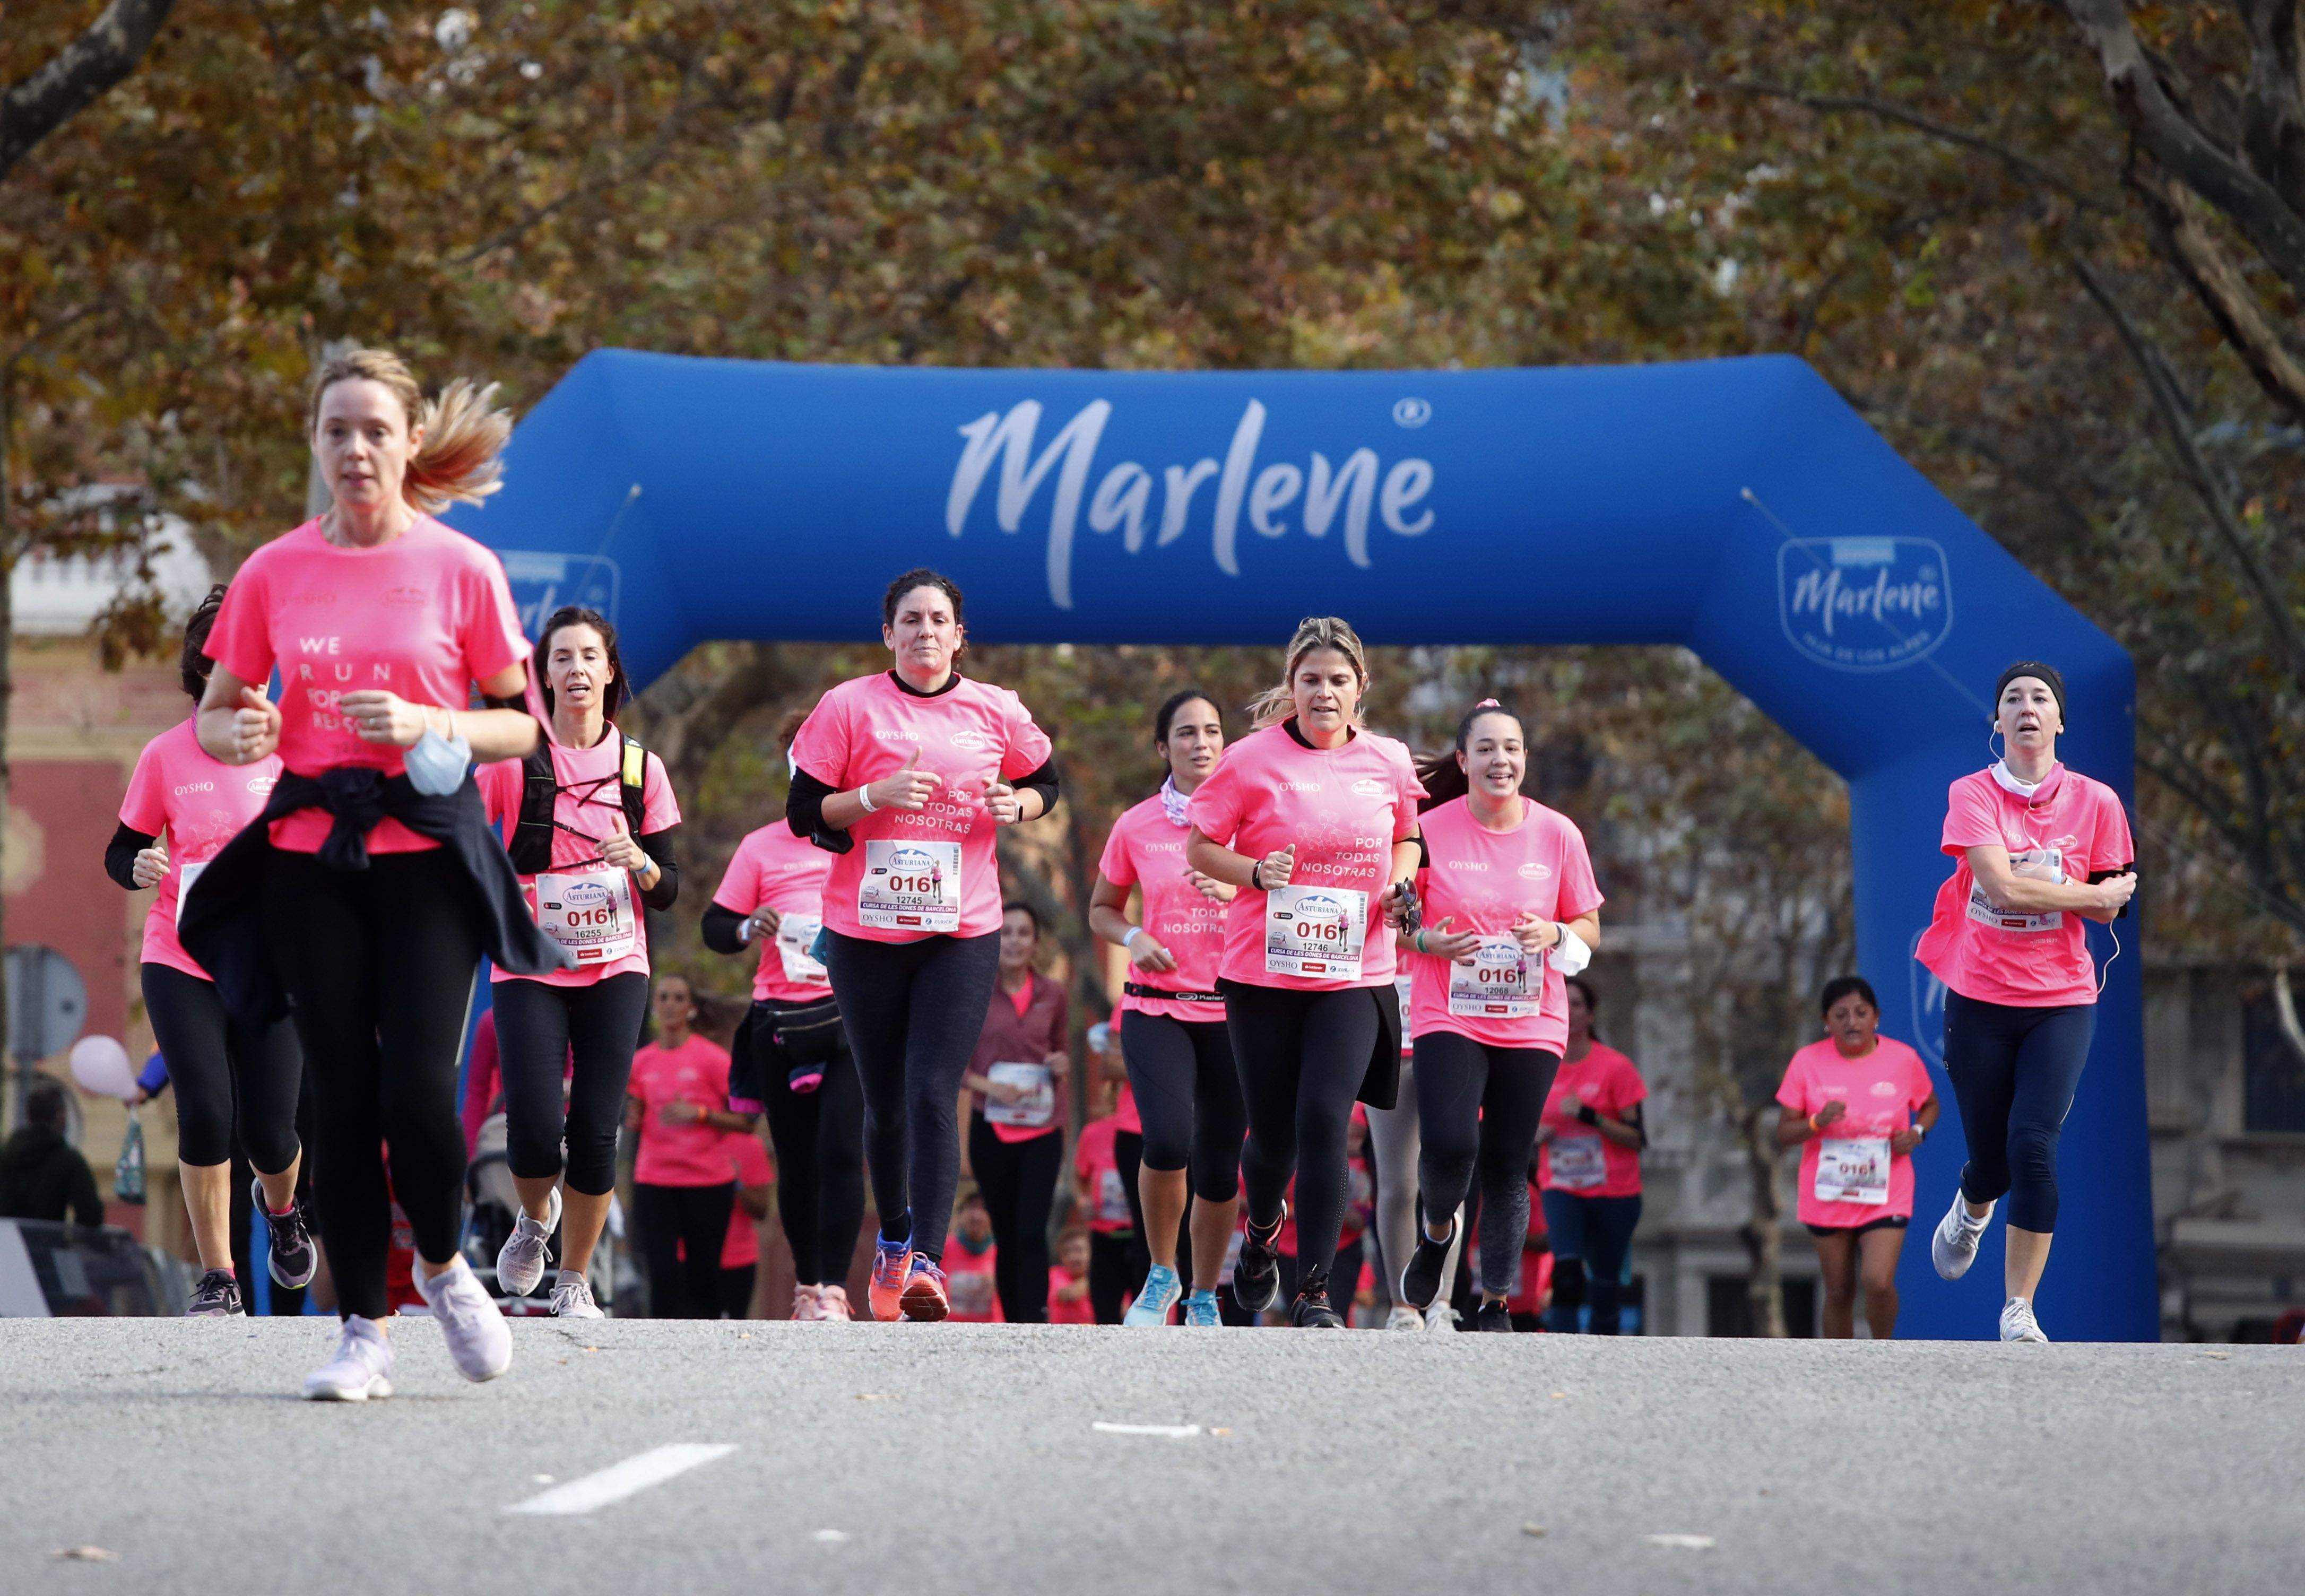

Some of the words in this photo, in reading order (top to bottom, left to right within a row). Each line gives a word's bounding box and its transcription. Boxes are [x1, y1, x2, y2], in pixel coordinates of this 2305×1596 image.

[946, 398, 1435, 610] Marlene
[1792, 567, 1940, 636] Marlene
[300, 637, 340, 655] WE
[876, 730, 918, 741] OYSHO
[175, 781, 214, 796] OYSHO
[1279, 782, 1320, 792] OYSHO
[948, 791, 972, 802] POR
[928, 802, 973, 817] TODAS
[895, 814, 971, 834] NOSOTRAS
[1145, 843, 1182, 852] OYSHO
[1355, 837, 1383, 848] POR
[892, 856, 930, 866] ASTURIANA
[1335, 852, 1380, 863] TODAS
[1302, 862, 1375, 878] NOSOTRAS
[1449, 860, 1488, 871] OYSHO
[889, 876, 930, 892] 016
[566, 891, 606, 901] ASTURIANA
[896, 896, 922, 905] 12745
[1298, 902, 1338, 914] ASTURIANA
[567, 908, 608, 926] 016
[862, 914, 892, 923] OYSHO
[575, 929, 601, 938] 16255
[1163, 923, 1225, 934] NOSOTRA
[1297, 922, 1337, 940] 016
[605, 932, 632, 942] BARCELONA
[1303, 942, 1328, 952] 12746
[1479, 950, 1517, 959] ASTURIANA
[1270, 959, 1298, 969] OYSHO
[1479, 968, 1517, 983] 016
[1840, 1163, 1869, 1174] 016
